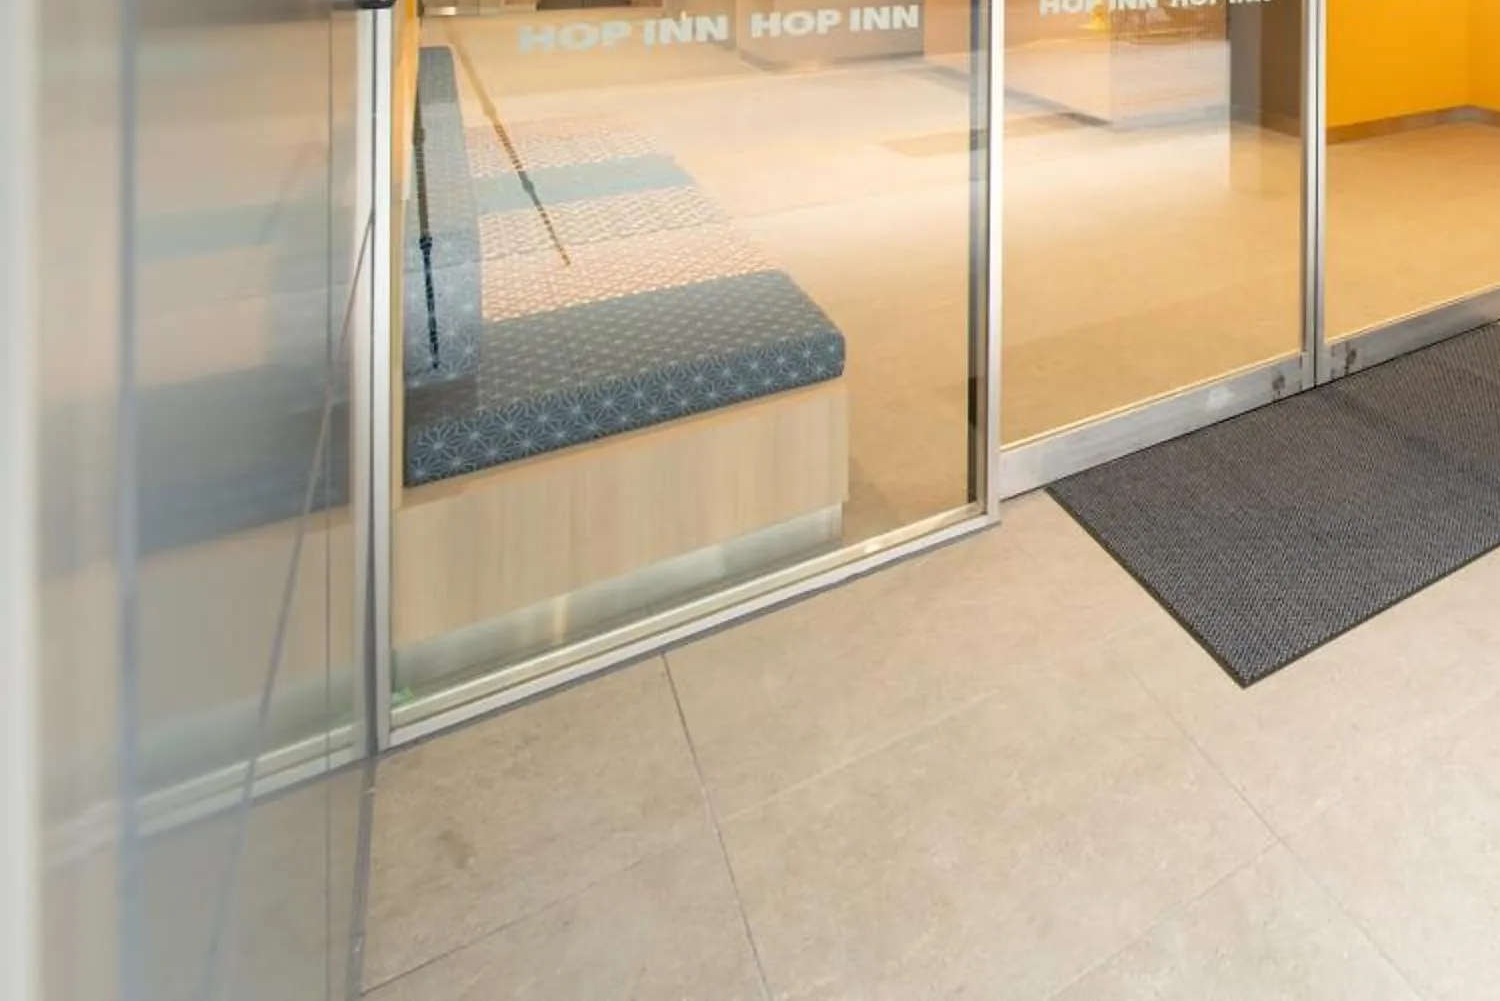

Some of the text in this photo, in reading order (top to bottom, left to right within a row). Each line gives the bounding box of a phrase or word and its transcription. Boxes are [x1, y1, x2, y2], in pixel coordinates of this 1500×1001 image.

[518, 13, 729, 54] HOP INN
[751, 4, 920, 38] HOP INN
